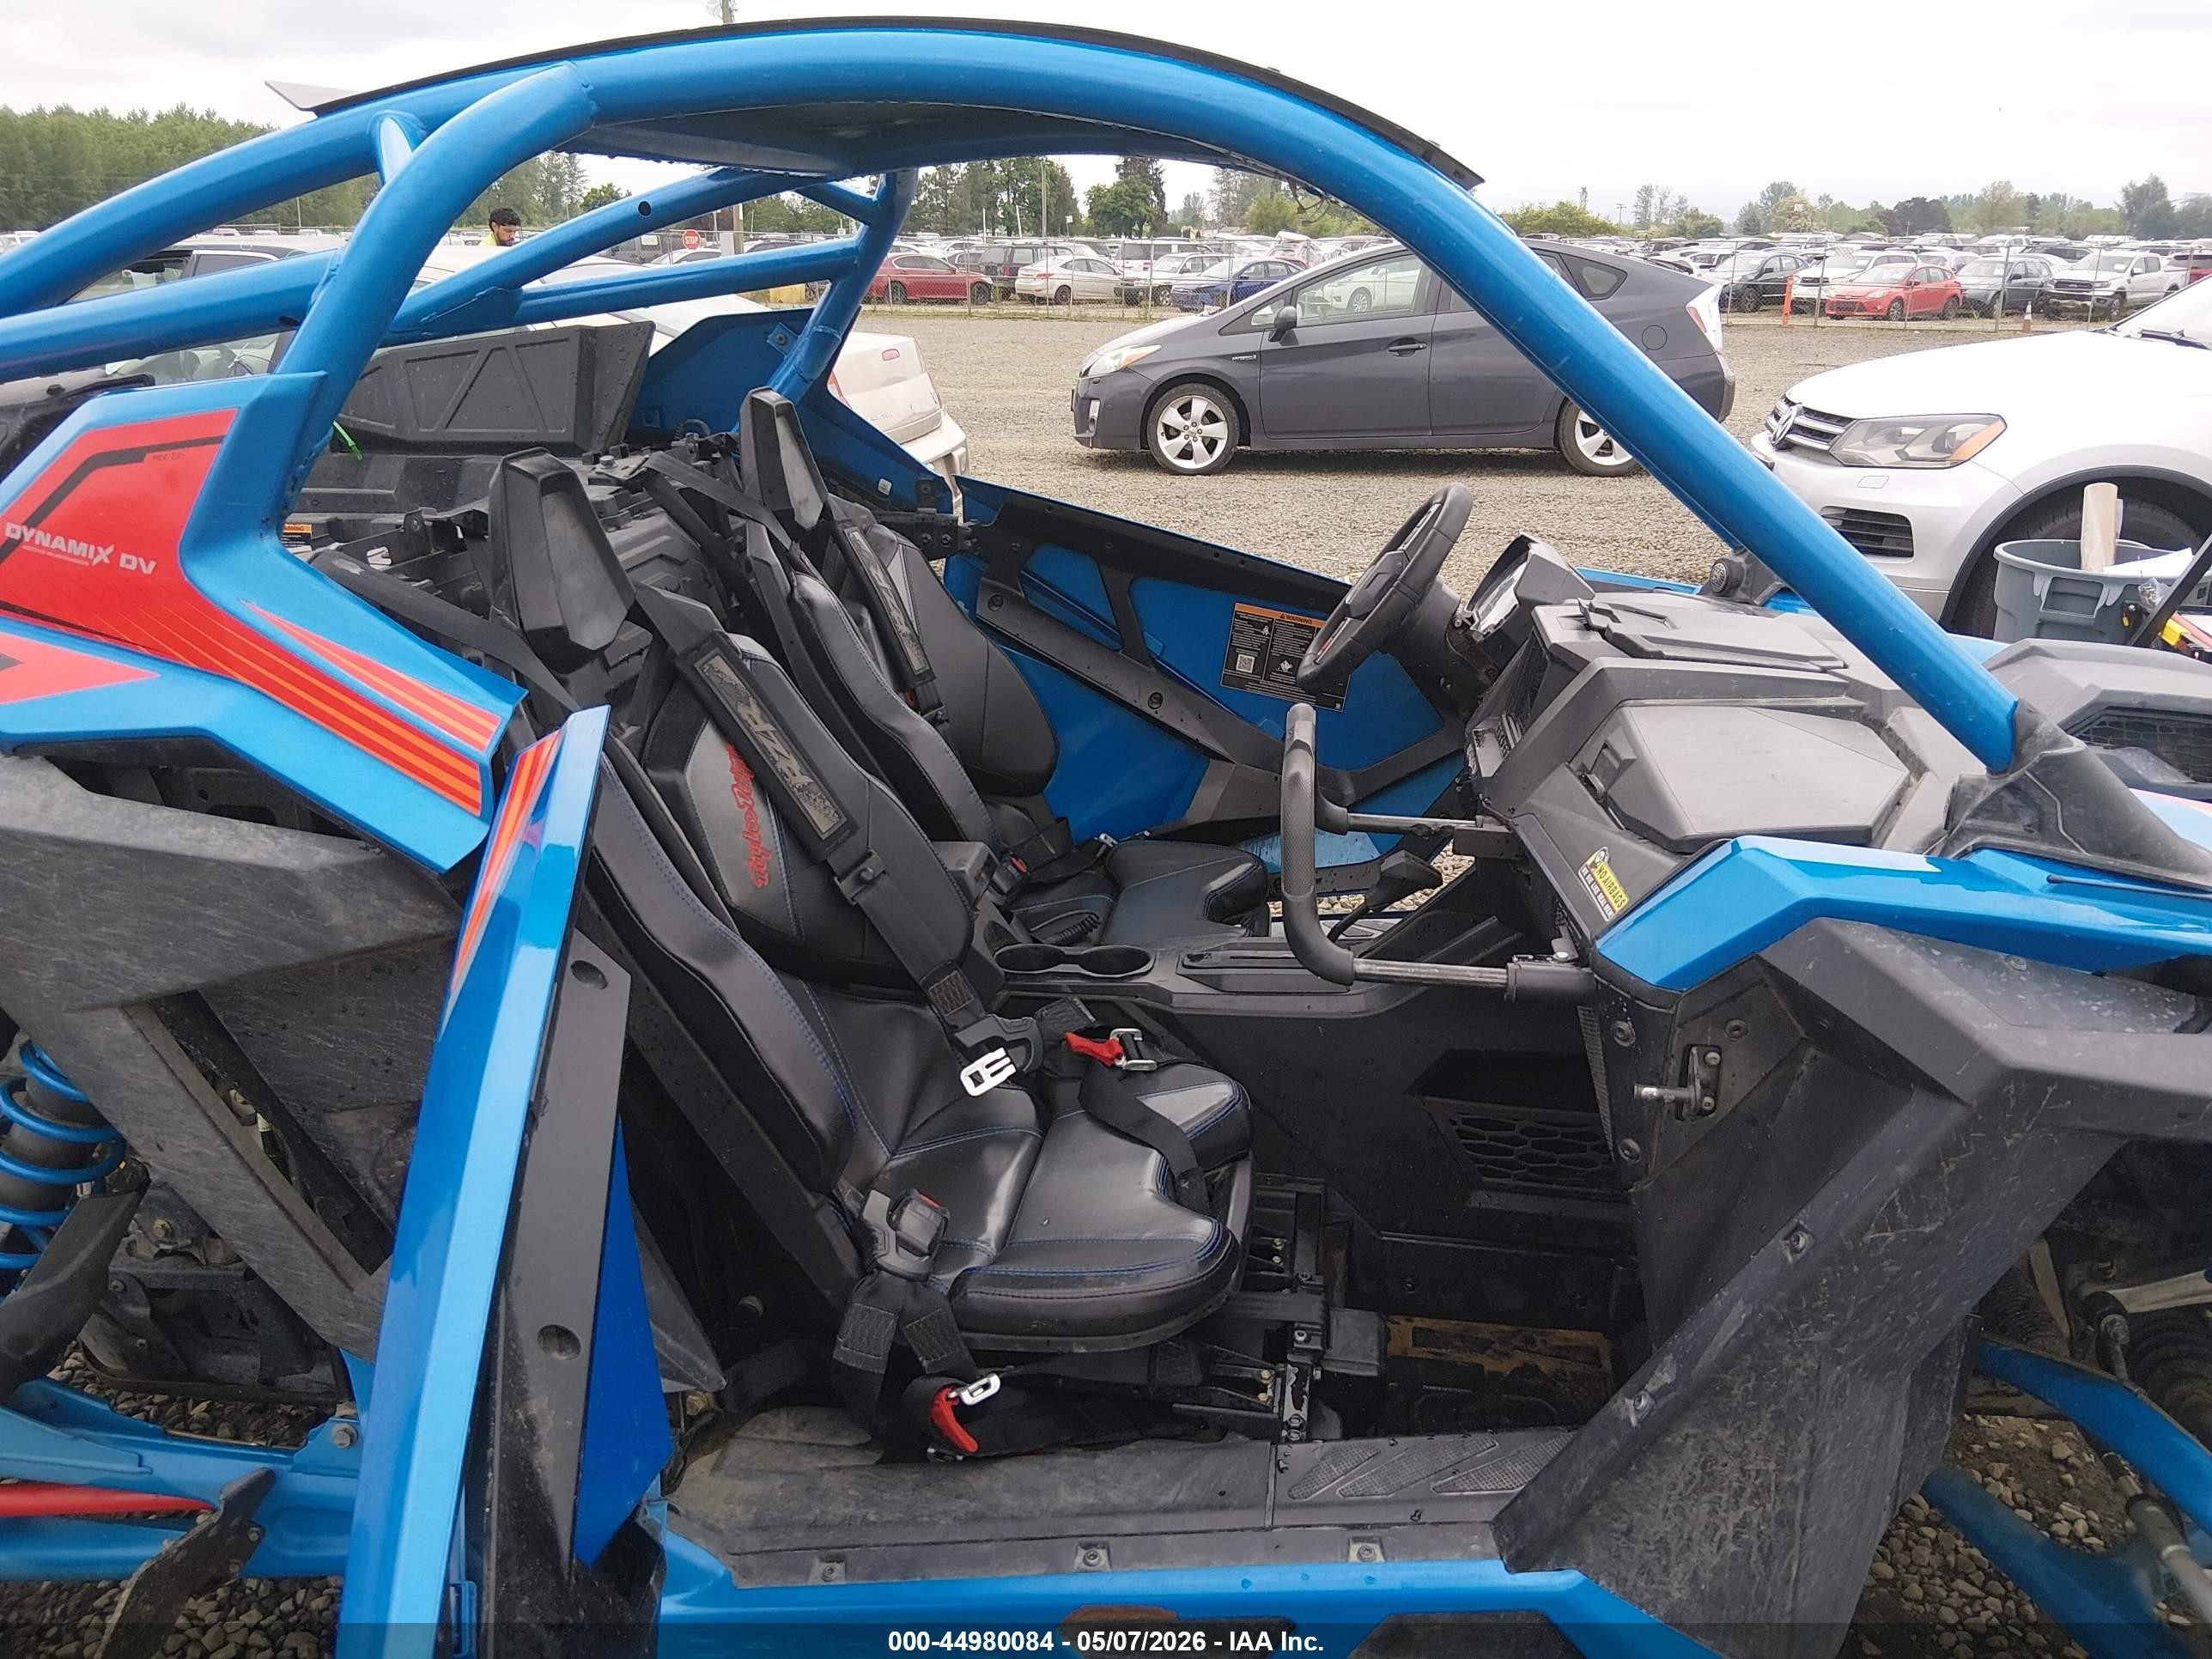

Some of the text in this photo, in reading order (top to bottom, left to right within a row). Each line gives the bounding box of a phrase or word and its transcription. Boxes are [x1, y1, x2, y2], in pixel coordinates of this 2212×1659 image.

[684, 235, 698, 245] STOP
[5, 522, 114, 566] DYNAMIX
[119, 553, 157, 574] DV
[1285, 615, 1313, 625] WARNING
[737, 696, 814, 784] RZR
[1595, 865, 1626, 908] NO AIRBAGS
